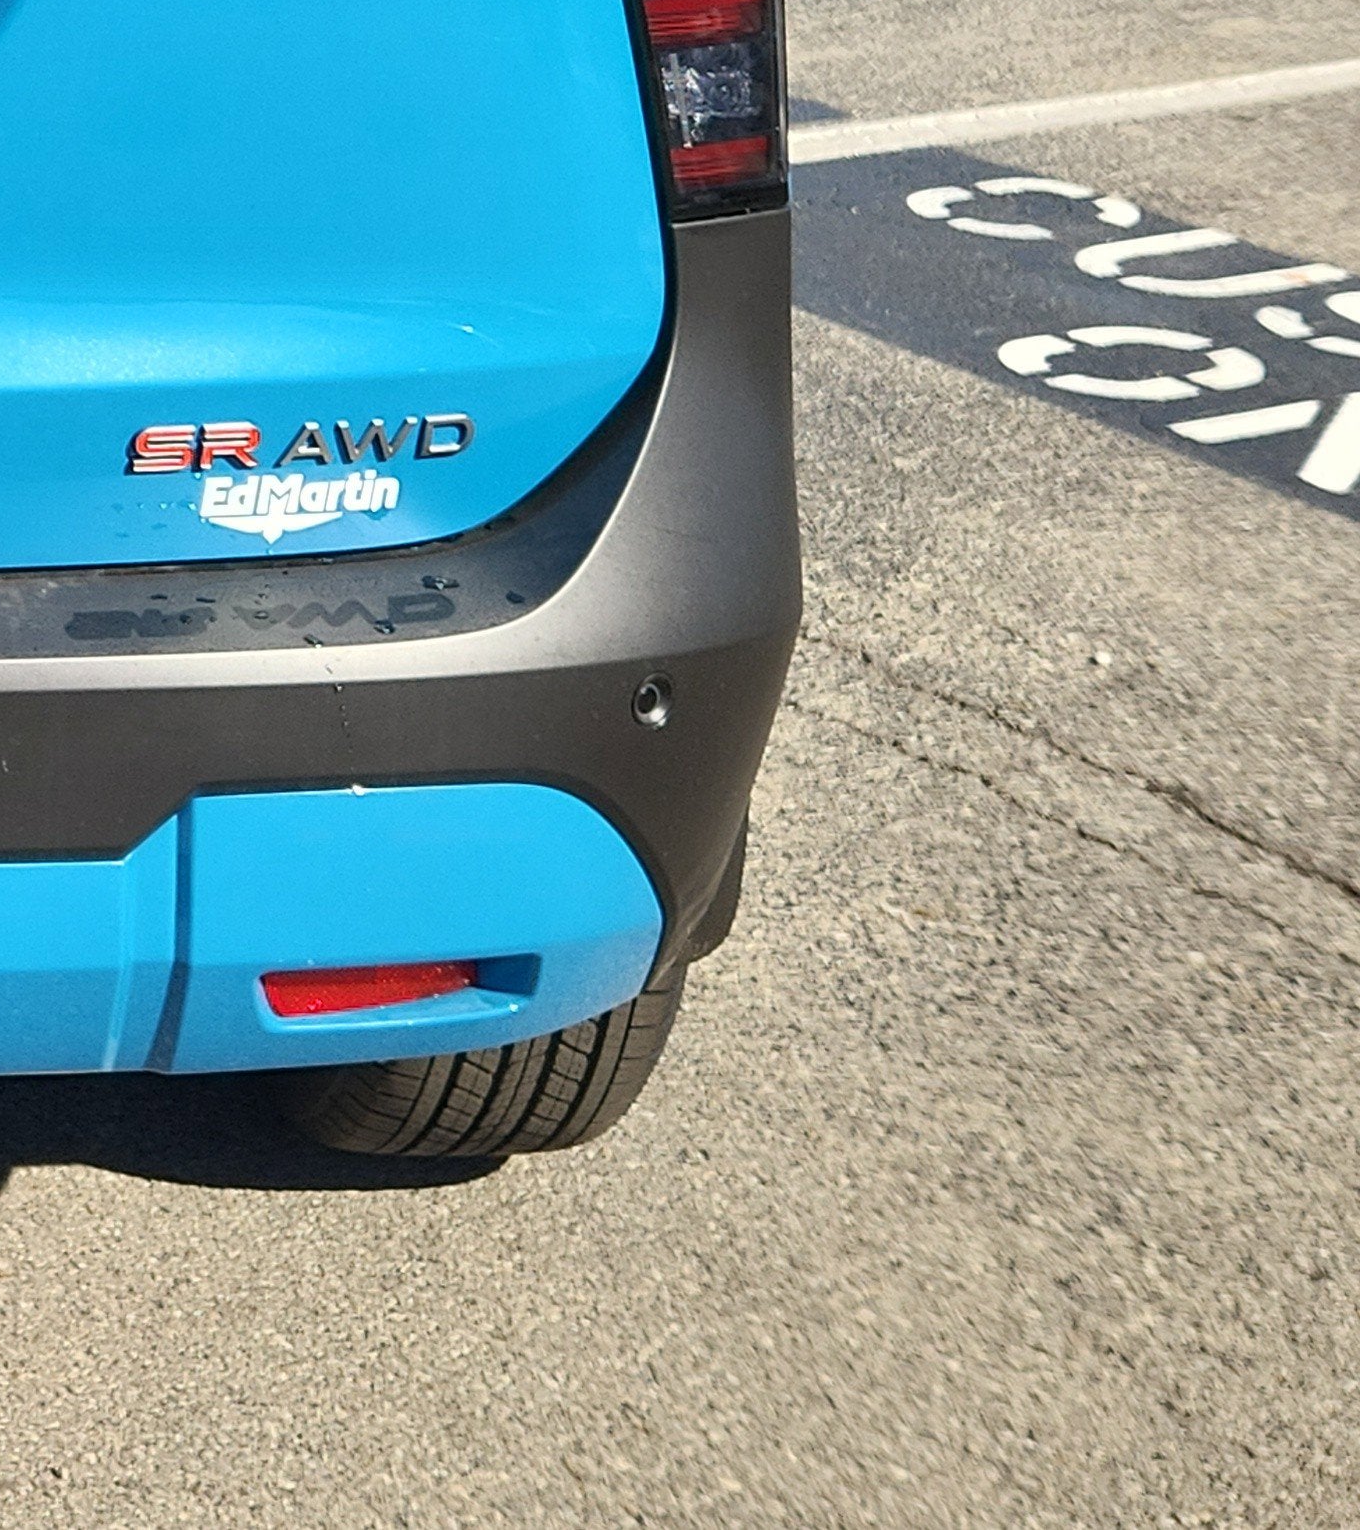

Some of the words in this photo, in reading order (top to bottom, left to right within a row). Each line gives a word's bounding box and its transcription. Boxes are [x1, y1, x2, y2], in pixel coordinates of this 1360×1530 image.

[130, 421, 261, 473] SR
[278, 413, 474, 466] AWD
[200, 471, 400, 518] EdMartin
